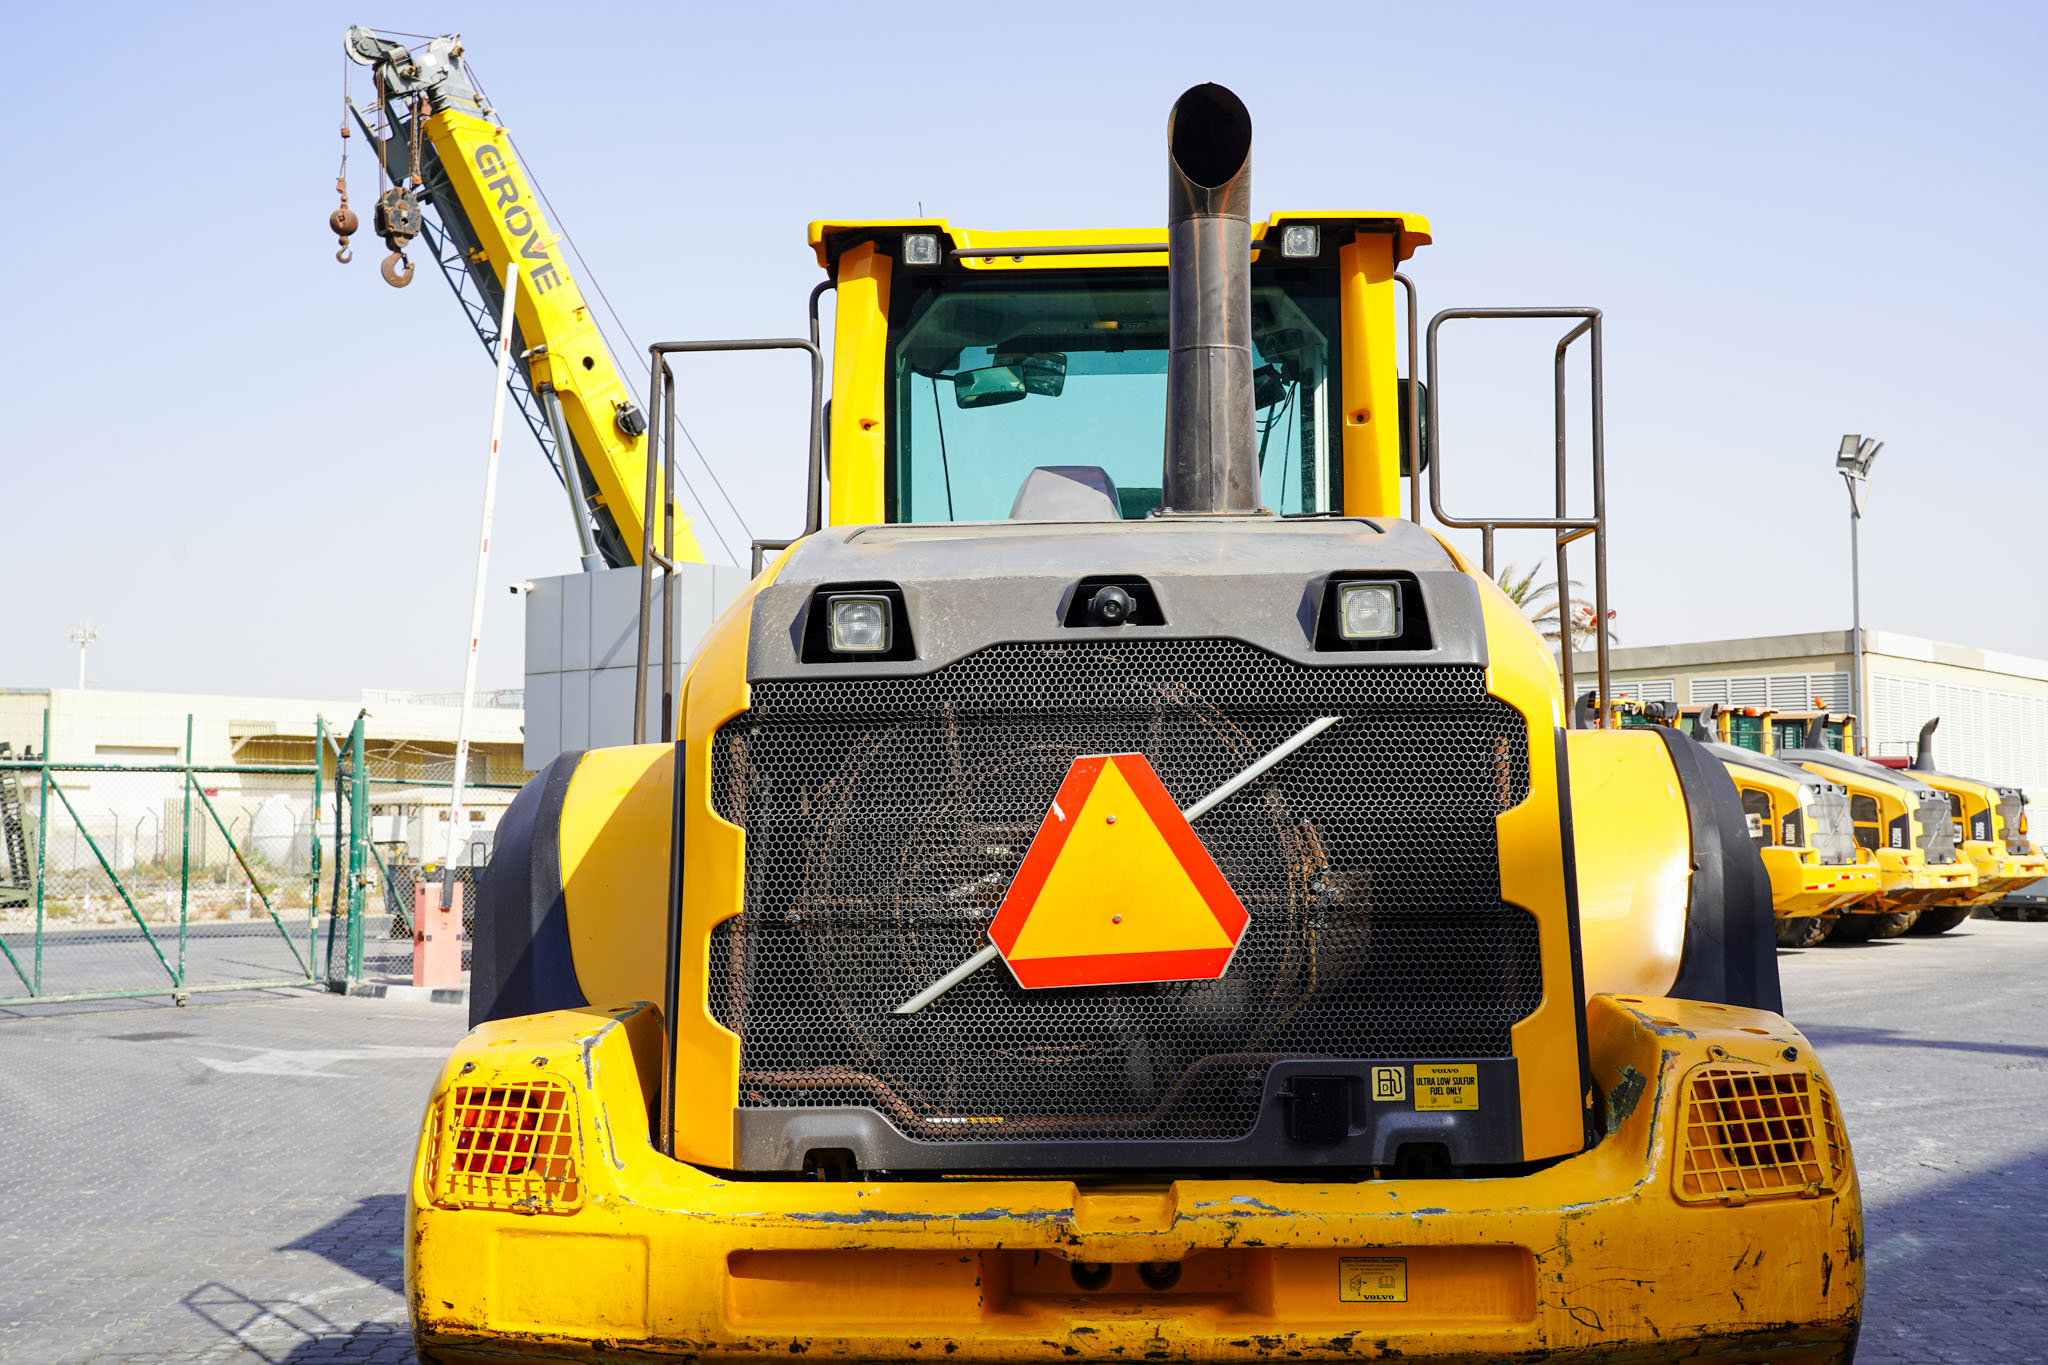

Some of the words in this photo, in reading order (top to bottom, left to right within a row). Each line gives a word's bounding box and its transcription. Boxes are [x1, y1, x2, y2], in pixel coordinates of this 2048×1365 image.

[475, 144, 562, 295] GROVE
[1416, 1077, 1435, 1086] ULTRA
[1437, 1077, 1451, 1086] LOW
[1453, 1076, 1475, 1086] SULFUR
[1382, 1084, 1389, 1092] D
[1430, 1087, 1445, 1095] FUEL
[1446, 1086, 1462, 1095] ONLY
